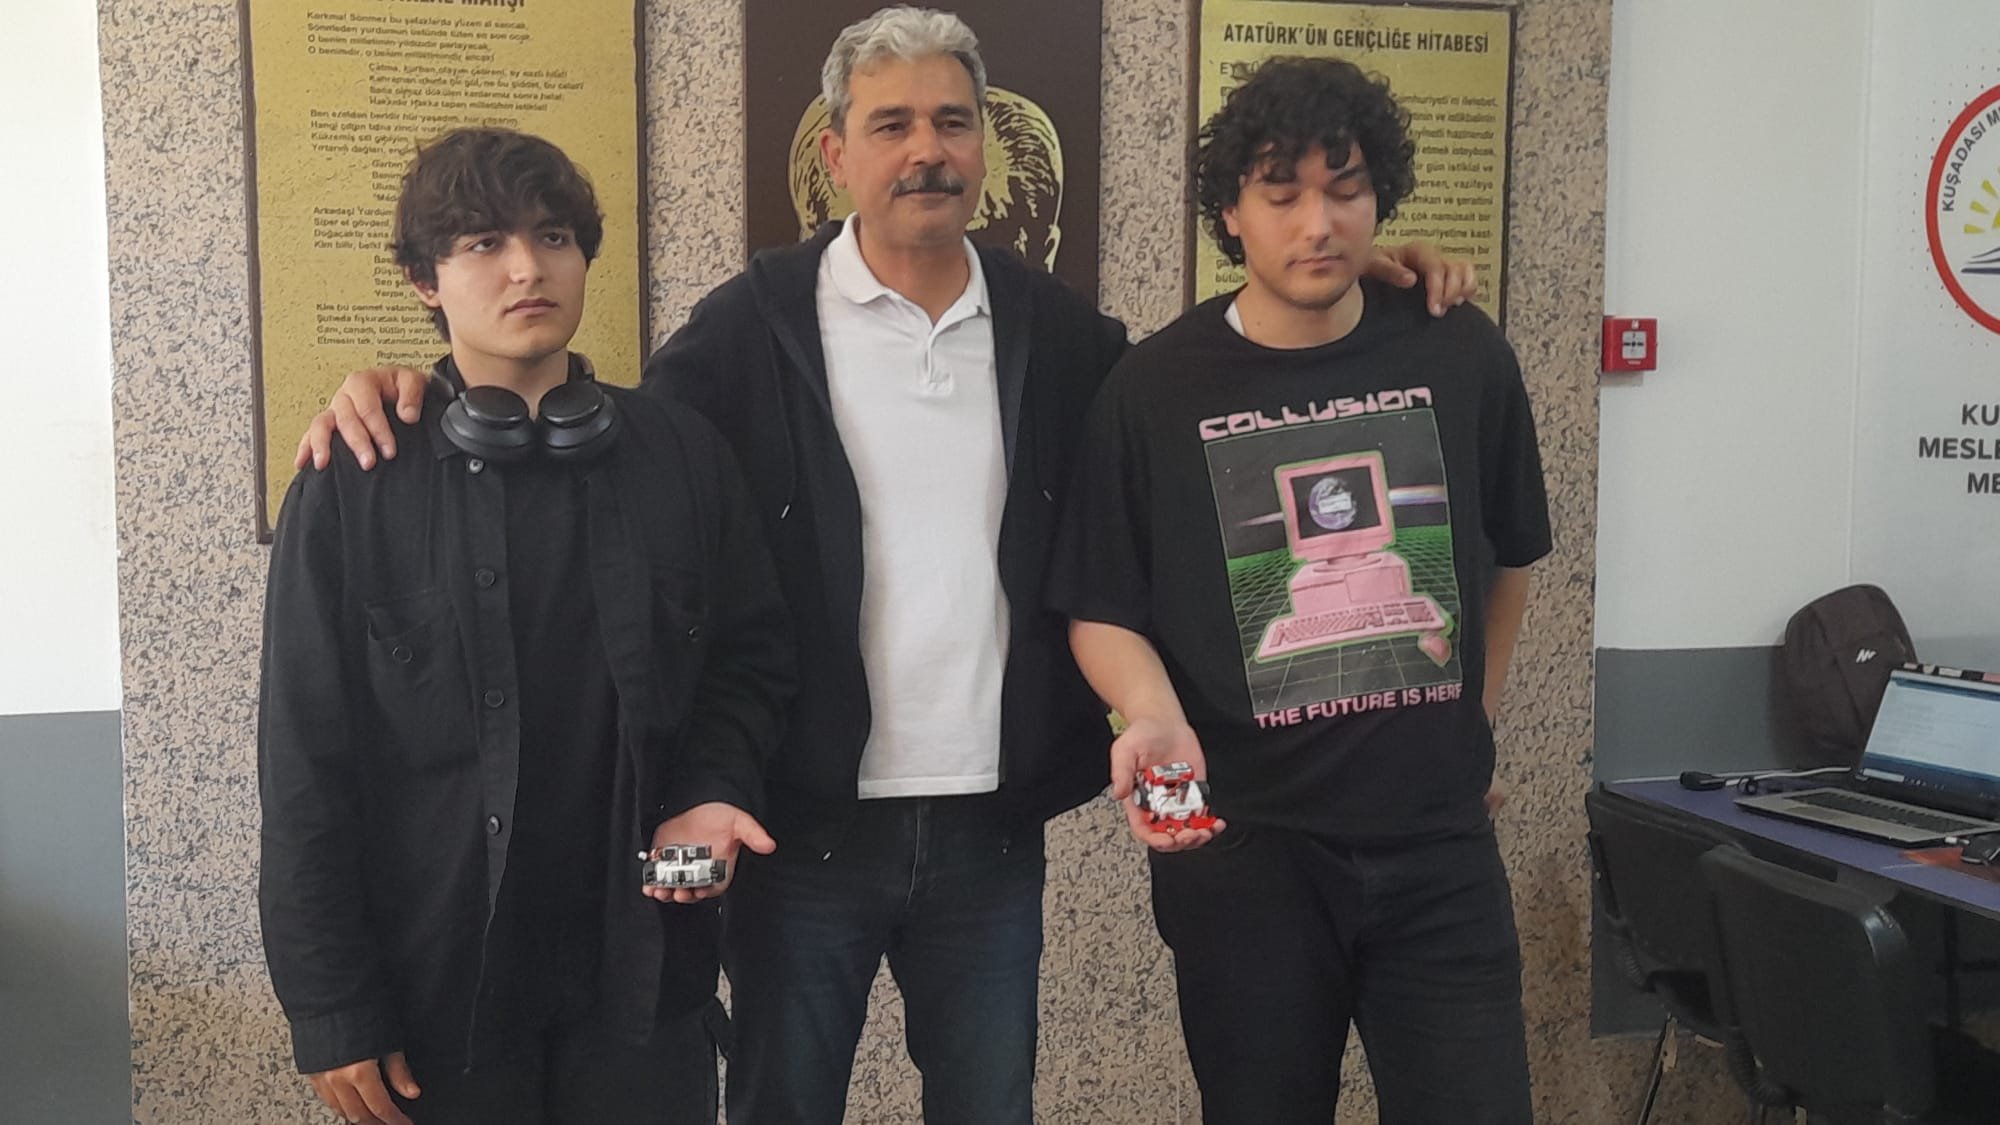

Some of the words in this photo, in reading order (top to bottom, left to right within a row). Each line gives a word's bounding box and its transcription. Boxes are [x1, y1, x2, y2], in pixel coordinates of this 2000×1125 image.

[1333, 27, 1412, 53] GENÇLİĞE
[1416, 29, 1489, 54] HİTABESİ
[1942, 121, 1987, 212] KUŞADASI
[1198, 387, 1432, 442] COLLUSION
[1962, 403, 2000, 426] KU
[1254, 707, 1303, 729] THE
[1306, 690, 1397, 720] FUTURE
[1401, 688, 1422, 706] IS
